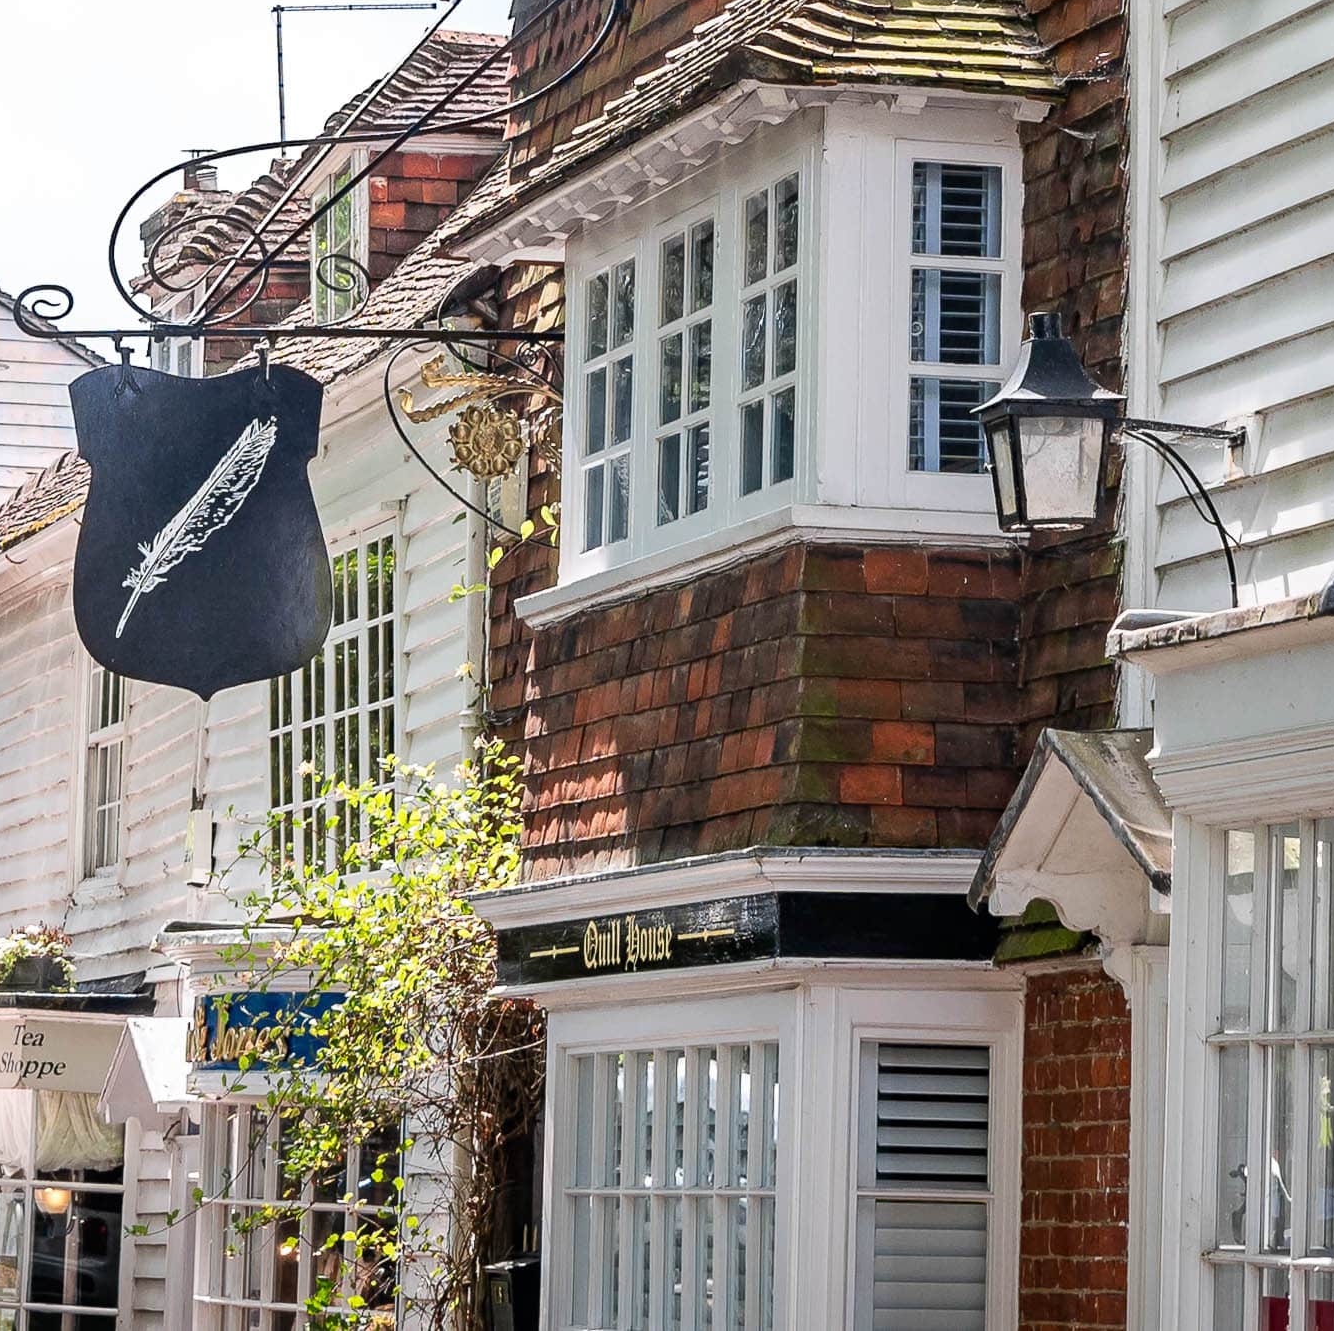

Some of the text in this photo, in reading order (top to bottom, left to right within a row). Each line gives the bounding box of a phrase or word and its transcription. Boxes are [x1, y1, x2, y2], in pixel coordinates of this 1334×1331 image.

[584, 913, 672, 972] Quill House
[13, 1025, 44, 1046] Tea
[0, 1052, 66, 1078] Shoppe
